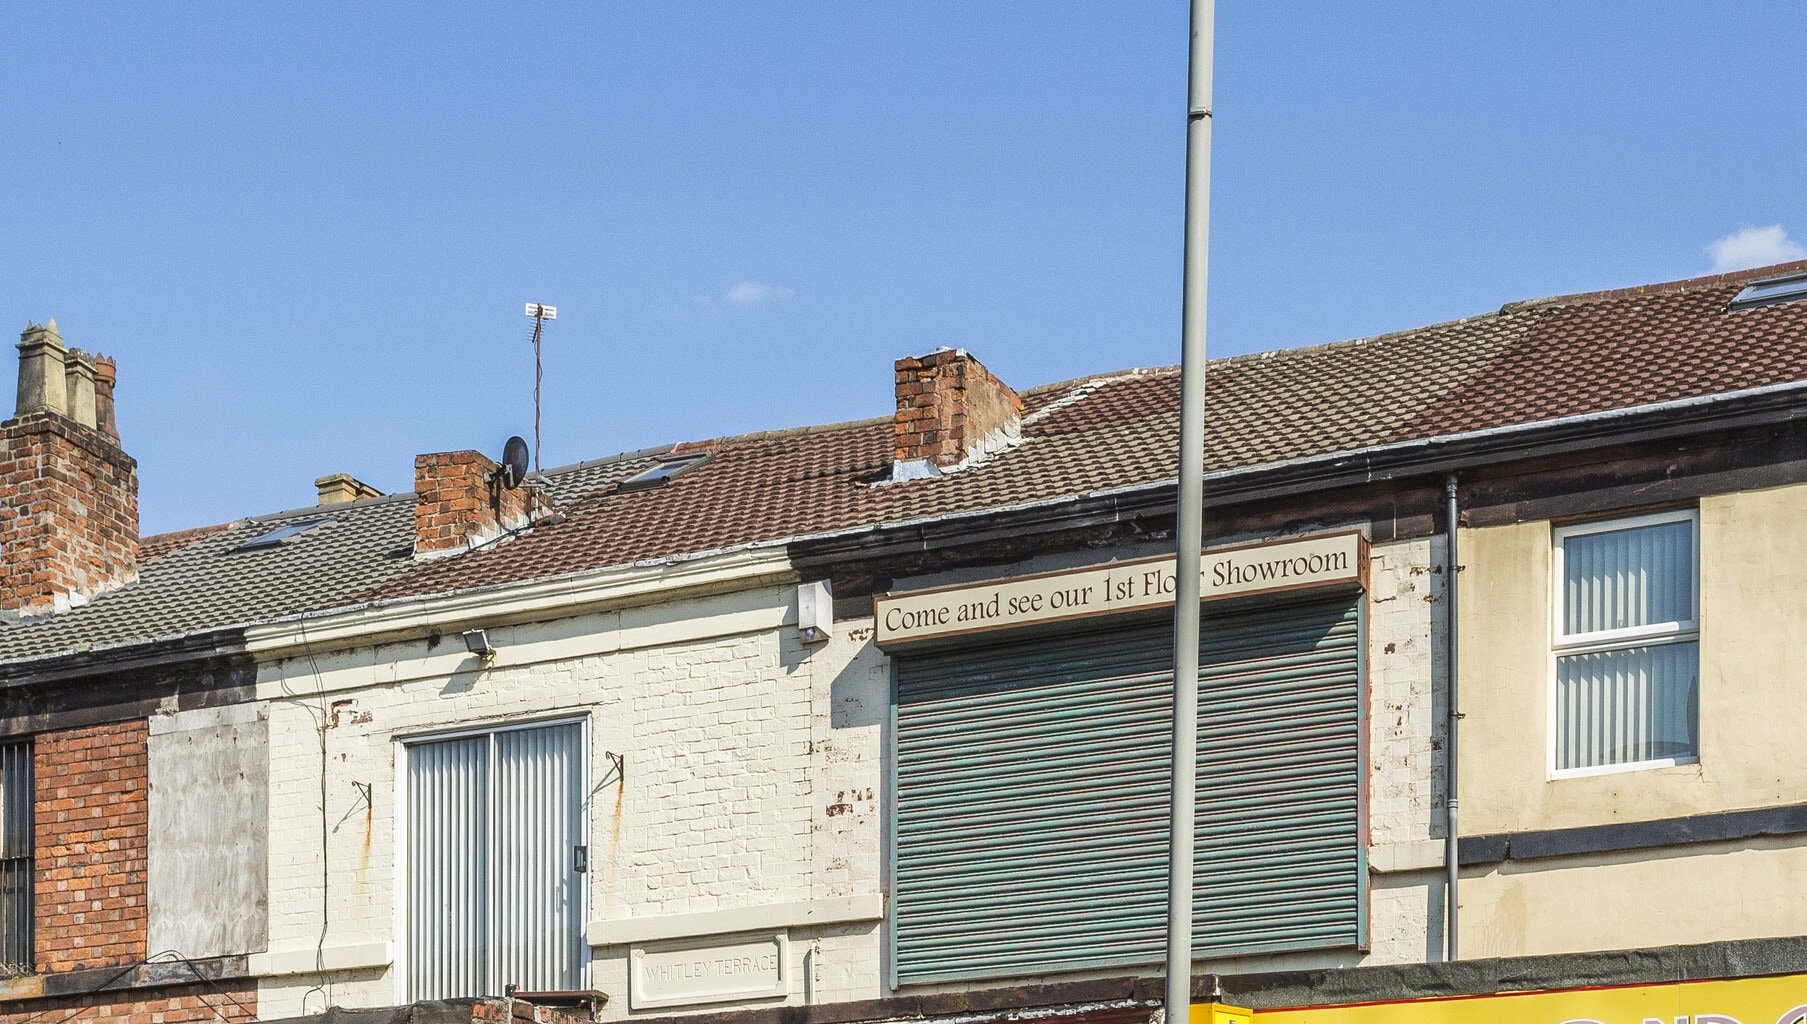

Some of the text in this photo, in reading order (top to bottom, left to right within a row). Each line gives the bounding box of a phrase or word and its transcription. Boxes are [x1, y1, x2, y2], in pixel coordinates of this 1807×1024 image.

[885, 551, 1348, 631] Come and see our 1st Flo Showroom
[645, 954, 777, 981] WHITLEY TERRACE
